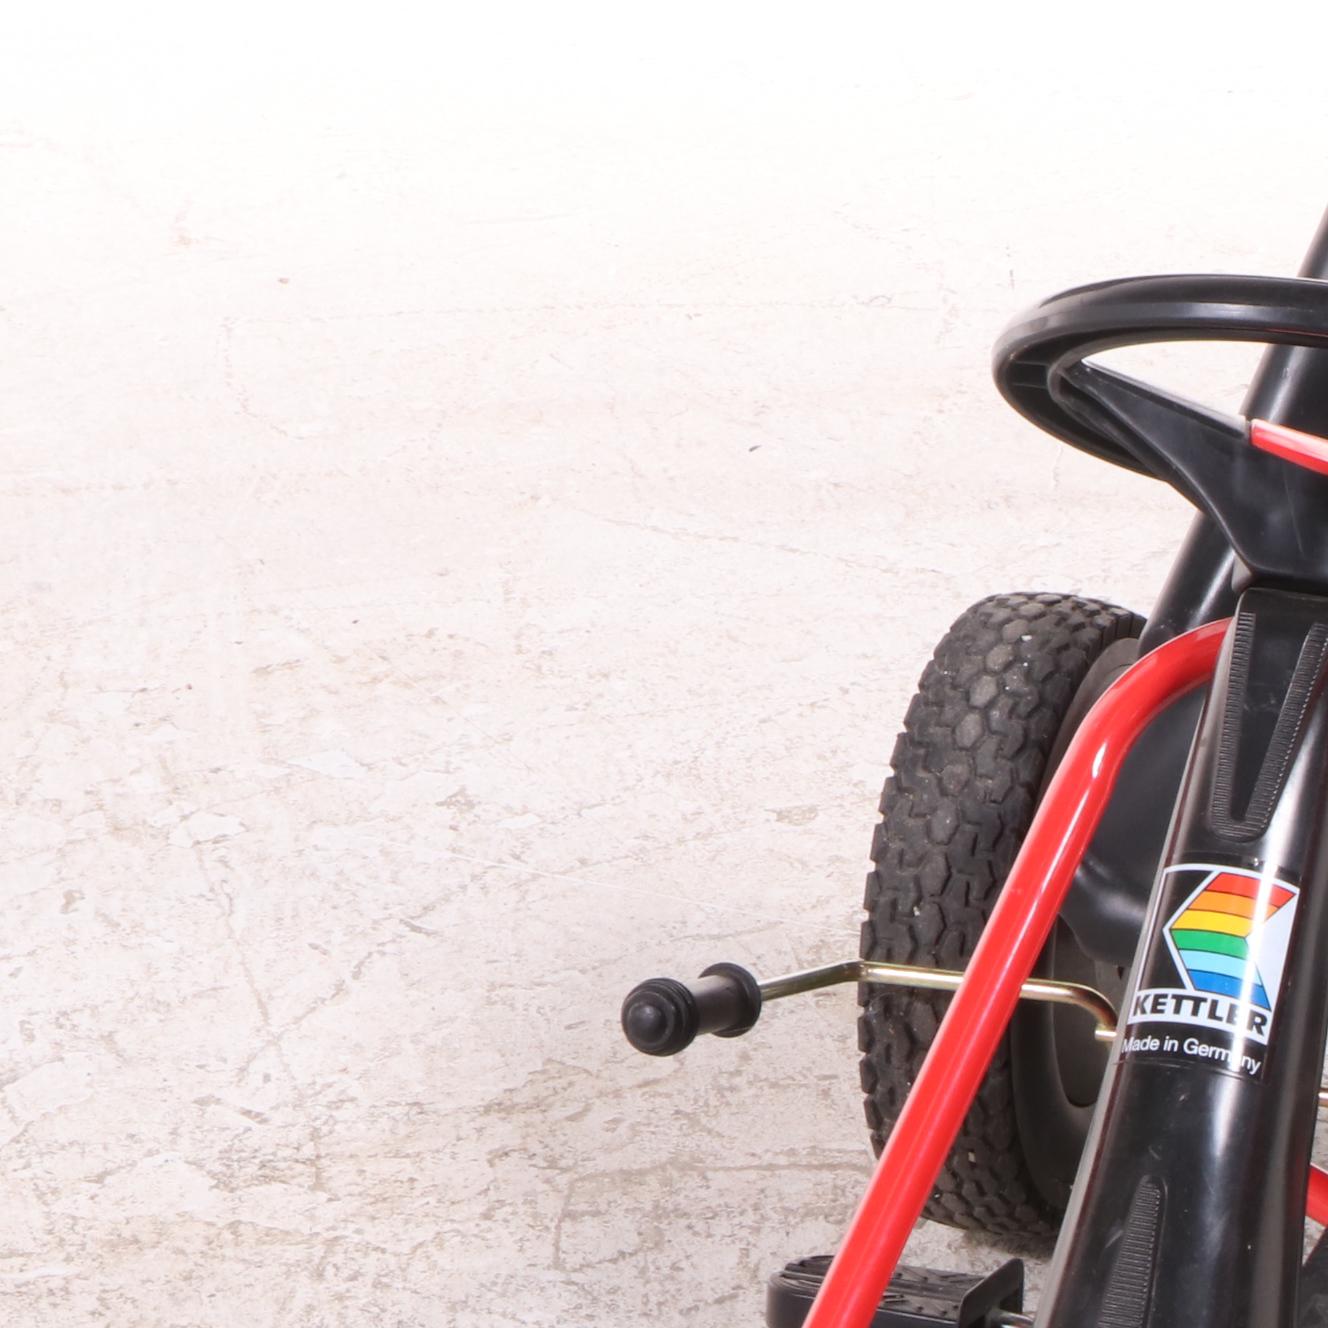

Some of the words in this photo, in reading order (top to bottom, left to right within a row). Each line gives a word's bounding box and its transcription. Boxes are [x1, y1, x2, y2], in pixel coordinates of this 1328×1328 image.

[1133, 993, 1268, 1036] KETTLER
[1121, 1035, 1160, 1053] Made
[1163, 1035, 1179, 1052] in
[1183, 1037, 1262, 1075] Germny
